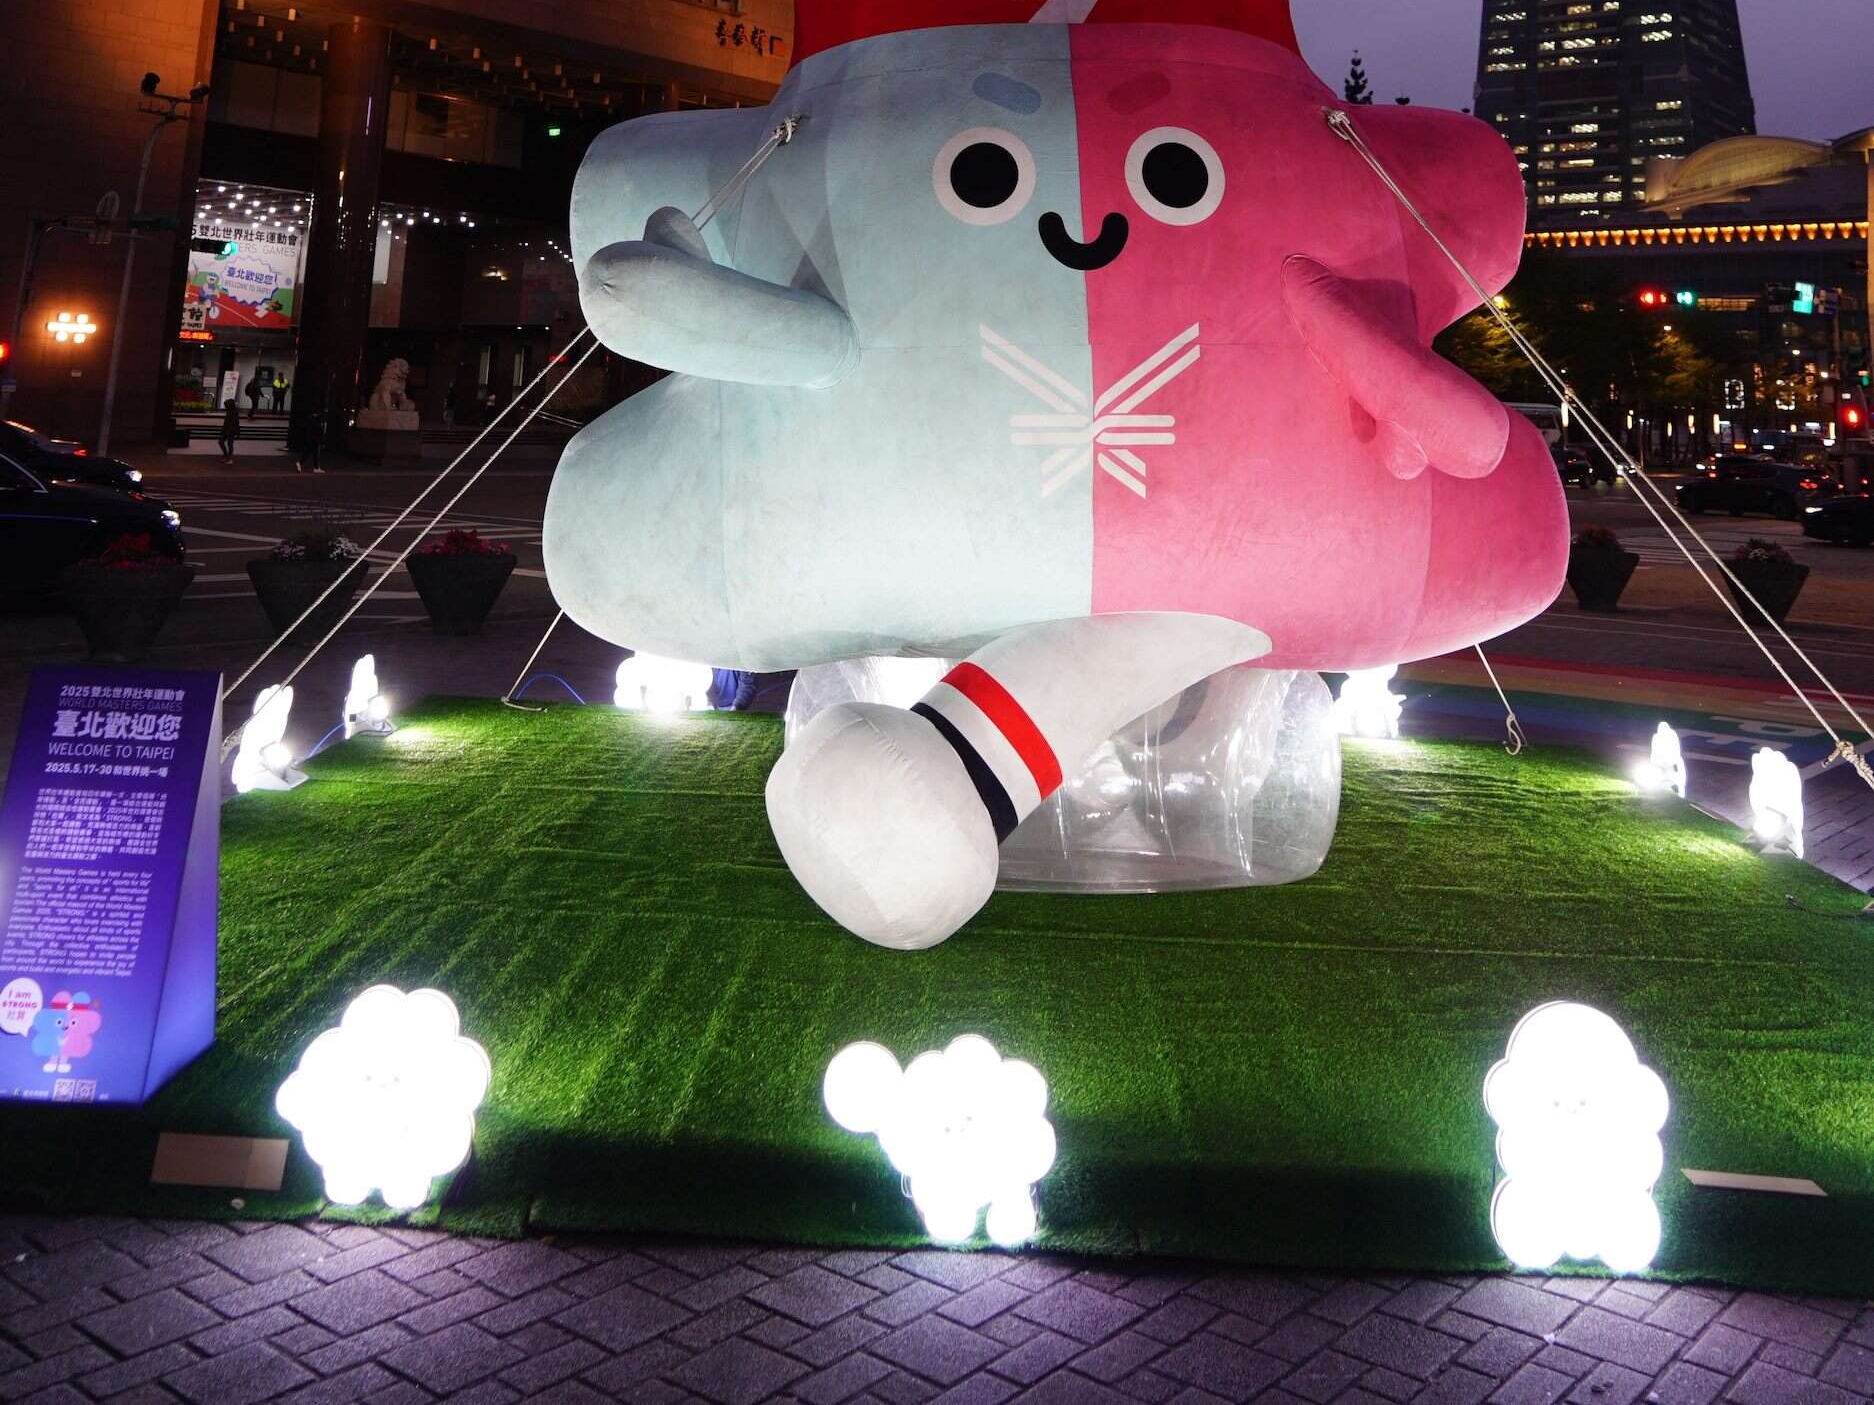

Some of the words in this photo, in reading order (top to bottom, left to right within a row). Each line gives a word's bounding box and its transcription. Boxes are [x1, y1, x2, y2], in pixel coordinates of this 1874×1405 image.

[262, 244, 296, 258] GAMES
[58, 697, 96, 708] WORLD
[51, 709, 183, 742] 臺北歡迎您
[48, 742, 113, 758] WELCOME
[114, 744, 132, 758] TO
[136, 745, 175, 761] TAIPEI
